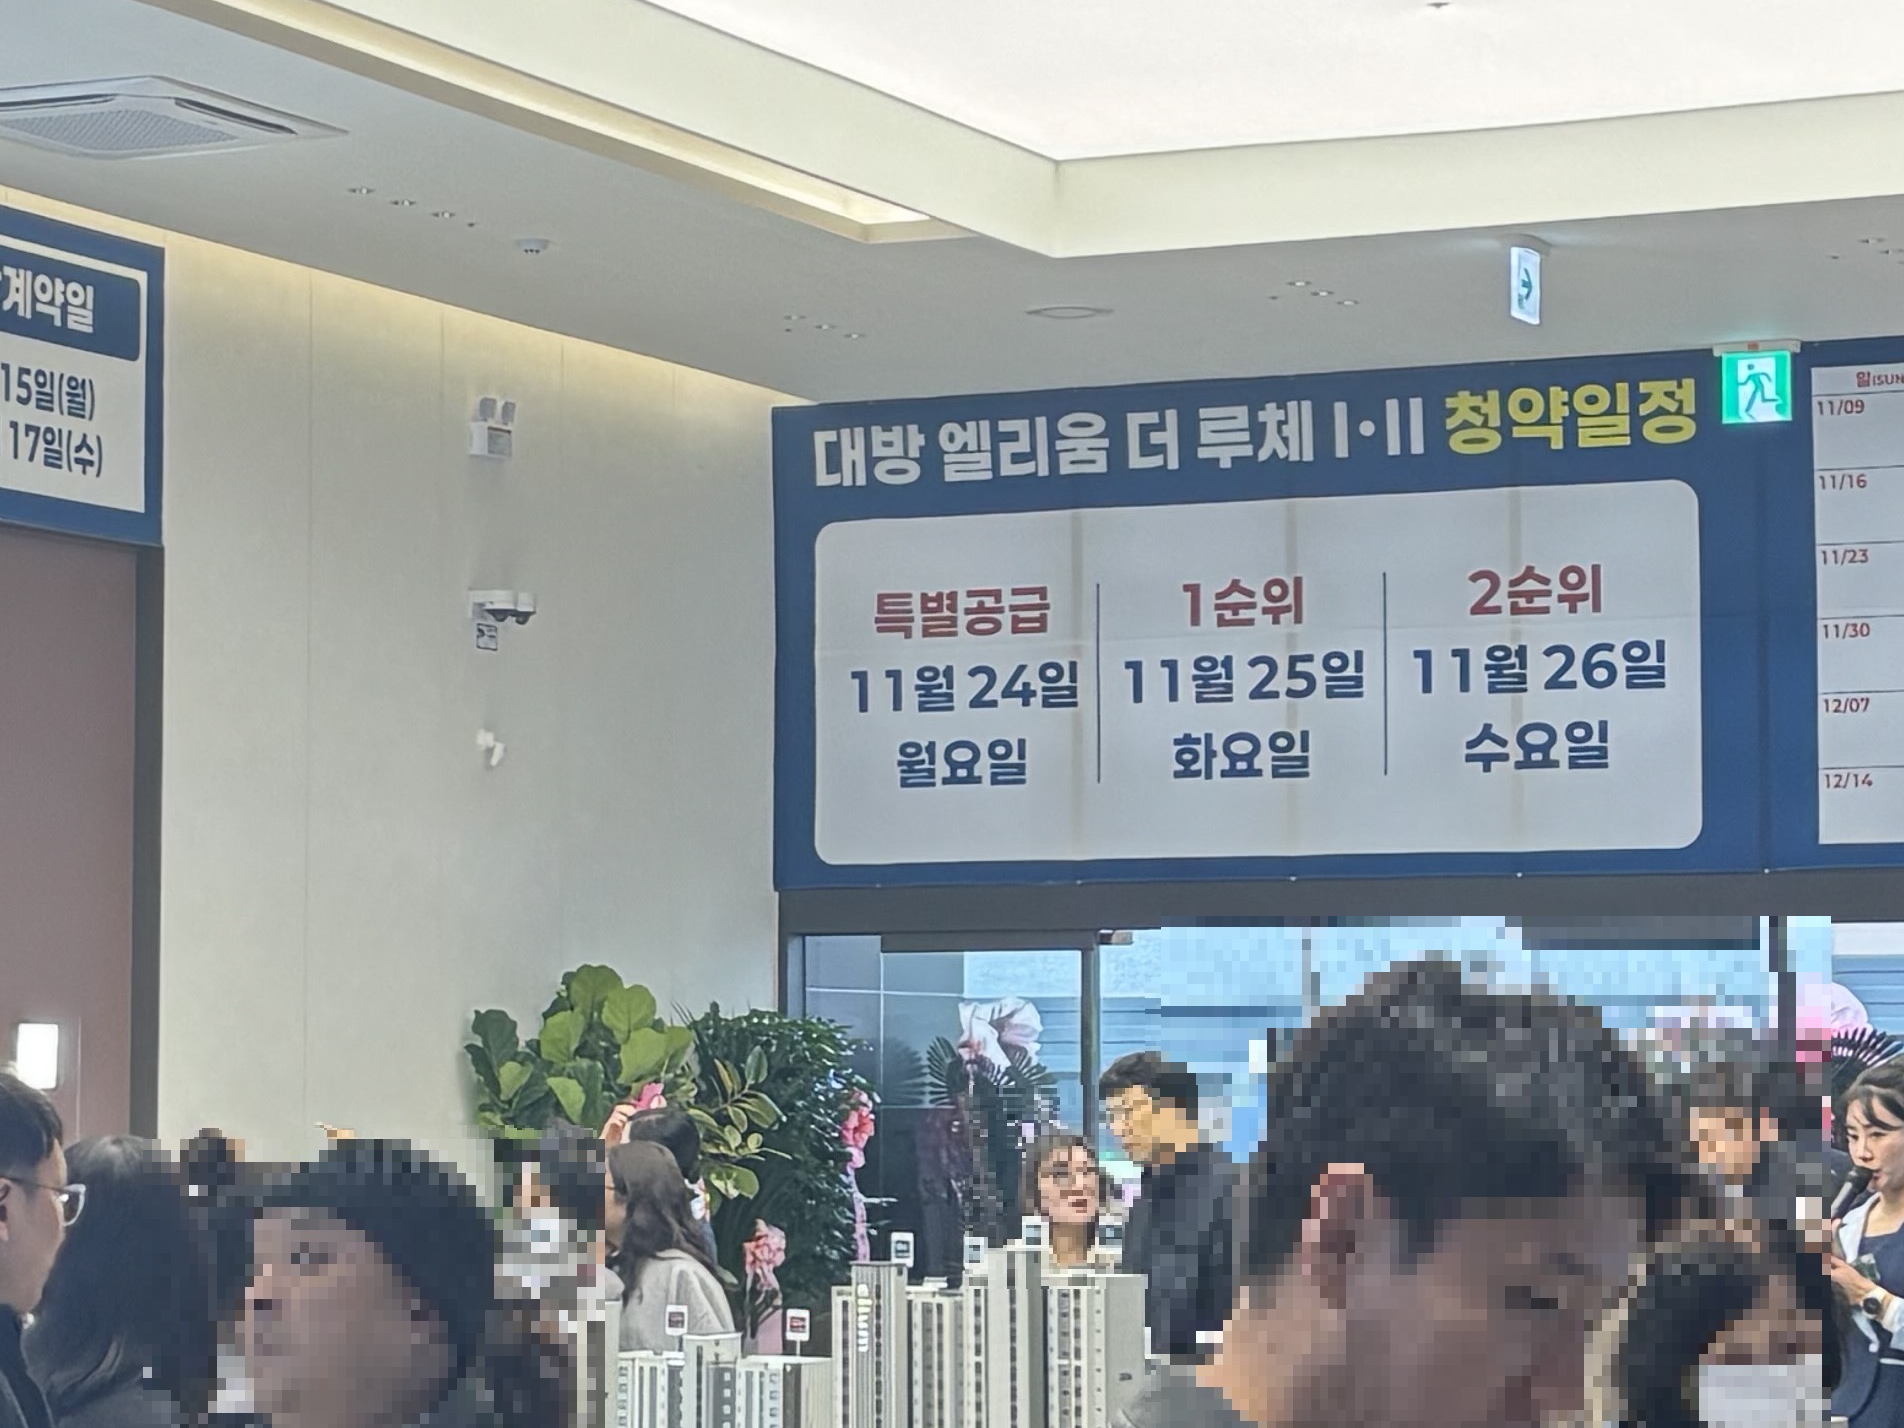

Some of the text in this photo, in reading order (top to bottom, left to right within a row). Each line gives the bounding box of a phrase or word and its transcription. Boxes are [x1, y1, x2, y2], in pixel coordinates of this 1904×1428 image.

[0, 361, 96, 422] 15일(월)
[1817, 399, 1865, 416] 11/09
[8, 420, 103, 479] 17일(수)
[813, 420, 926, 488] 대방
[940, 409, 1111, 483] 엘리움
[1126, 406, 1180, 472] 더
[1196, 401, 1314, 470] 루체
[1444, 375, 1698, 457] 청약일정
[1819, 473, 1867, 491] 11/16
[1820, 548, 1869, 565] 11/23
[872, 583, 1052, 640] 특별공급
[1181, 575, 1305, 630] 1순위
[1467, 563, 1605, 618] 2순위
[1822, 622, 1871, 640] 11/30
[849, 658, 1081, 713] 11월 24일
[1122, 647, 1366, 706] 11월 25일
[1412, 637, 1669, 697] 11월 26일
[1823, 696, 1870, 714] 12/07
[895, 737, 1029, 790] 월요일
[1171, 729, 1312, 782] 화요일
[1463, 718, 1611, 776] 수요일
[1824, 772, 1873, 789] 12/14
